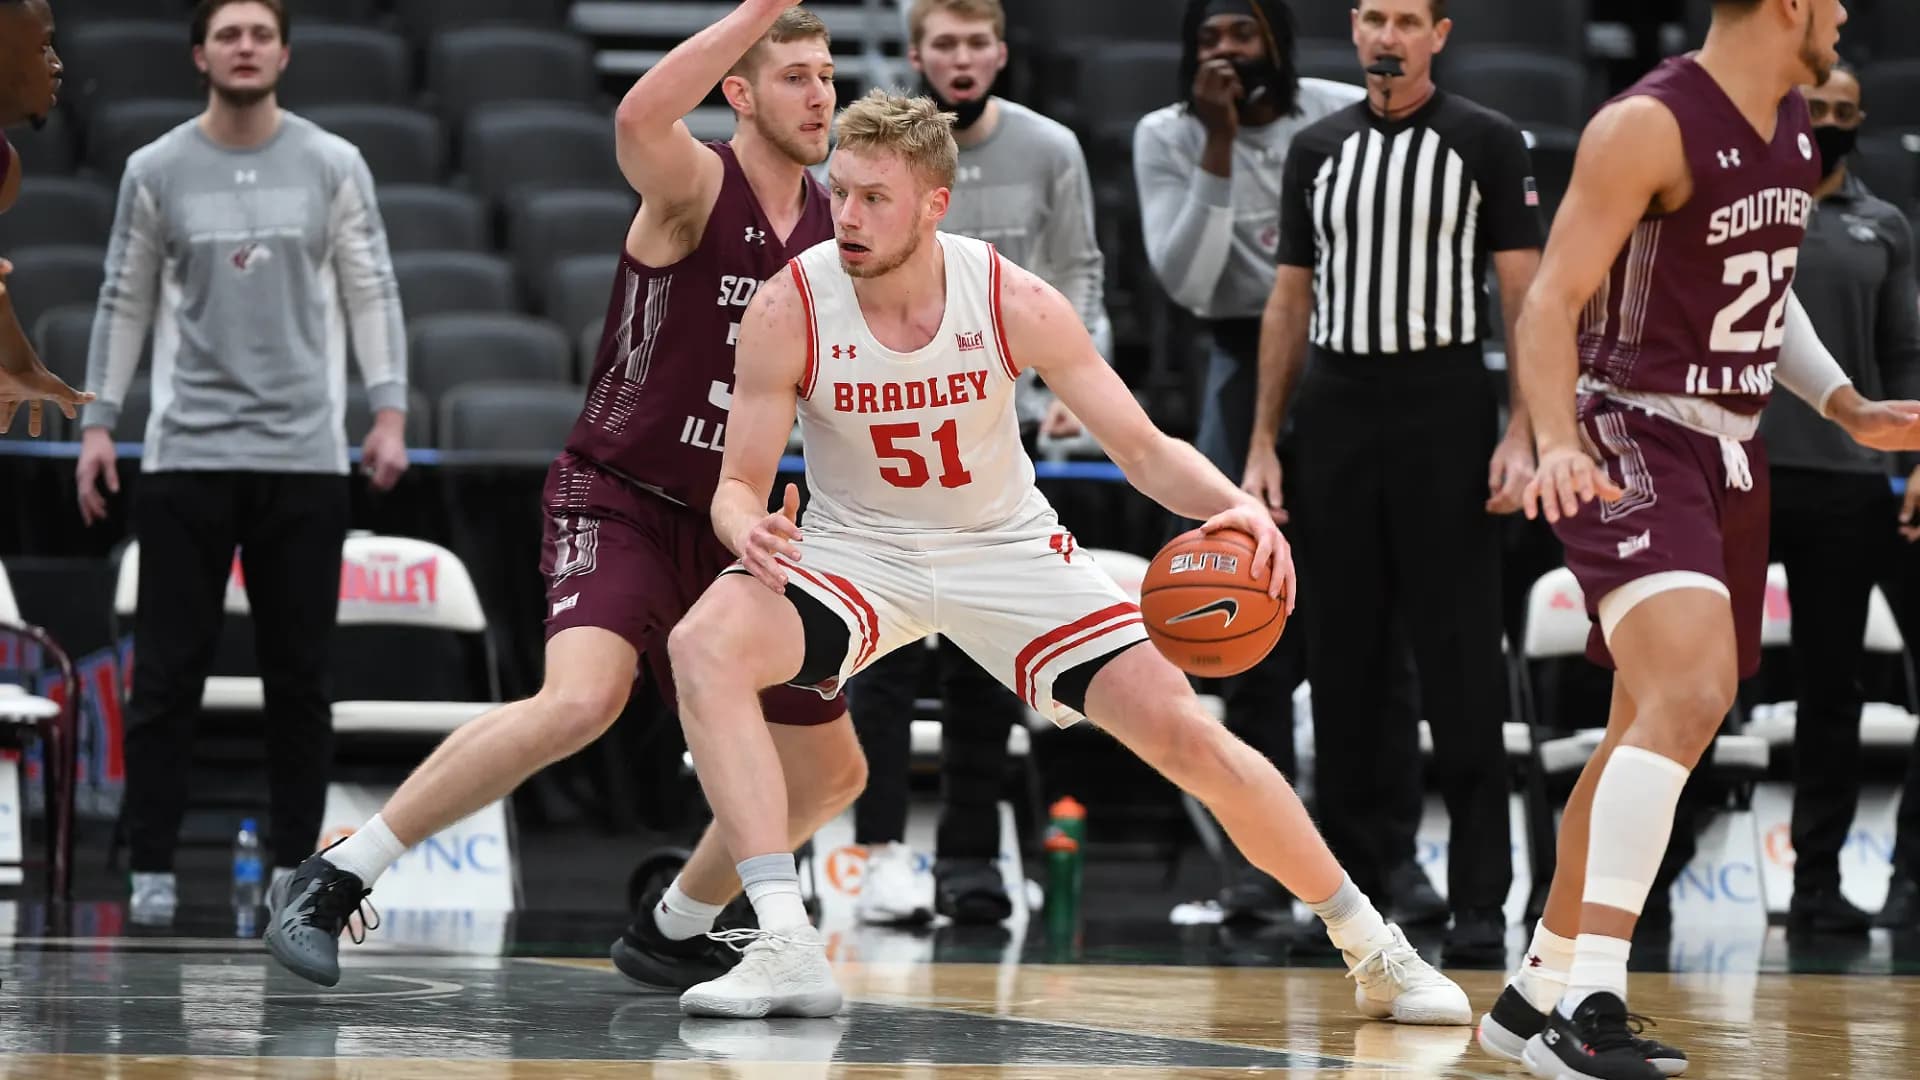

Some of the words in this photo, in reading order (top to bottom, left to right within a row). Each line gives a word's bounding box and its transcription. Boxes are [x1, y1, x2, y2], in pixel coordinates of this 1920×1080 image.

[717, 275, 766, 307] SO
[1709, 247, 1798, 352] 22
[955, 330, 984, 348] VALLEY
[833, 370, 988, 413] BRADLEY
[869, 418, 972, 488] 51
